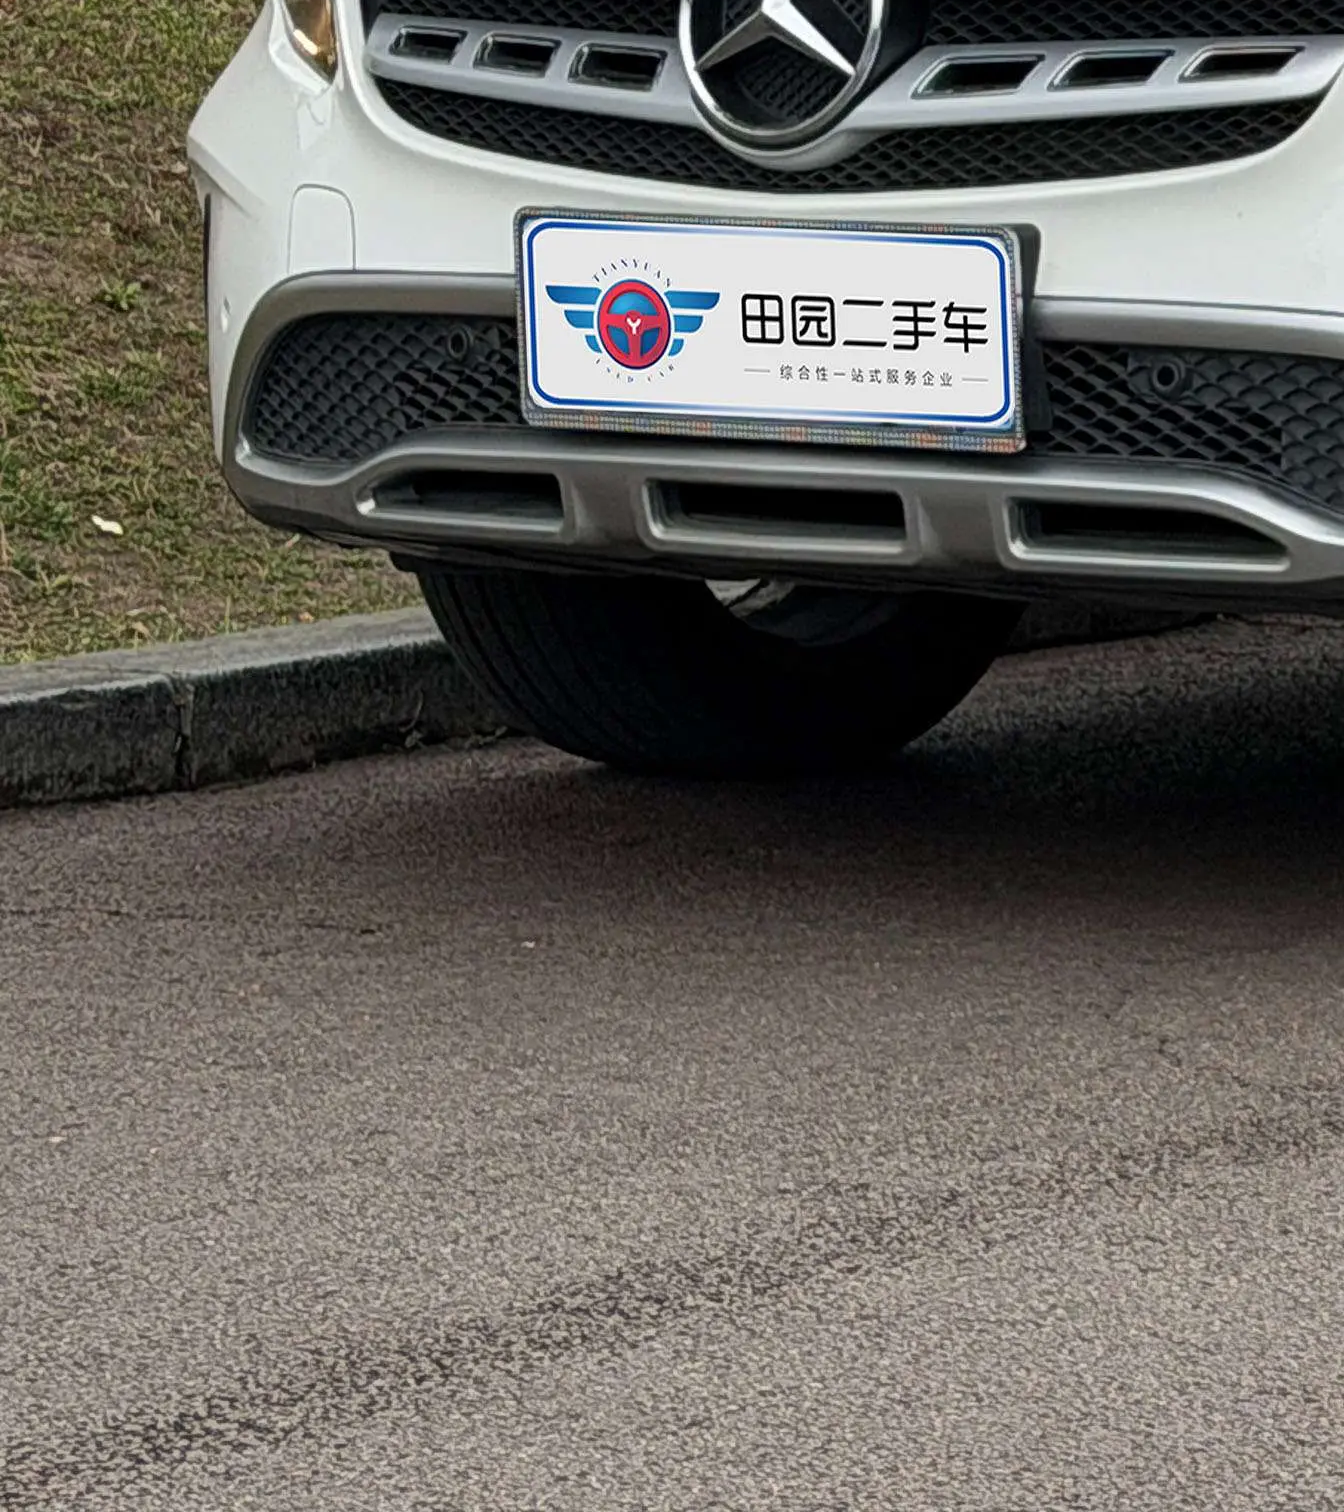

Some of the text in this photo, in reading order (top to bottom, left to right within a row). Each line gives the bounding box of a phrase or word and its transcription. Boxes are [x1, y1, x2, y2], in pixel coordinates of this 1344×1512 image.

[741, 293, 988, 353] 田园二手车
[779, 363, 952, 387] 综合性一站式服务企业
